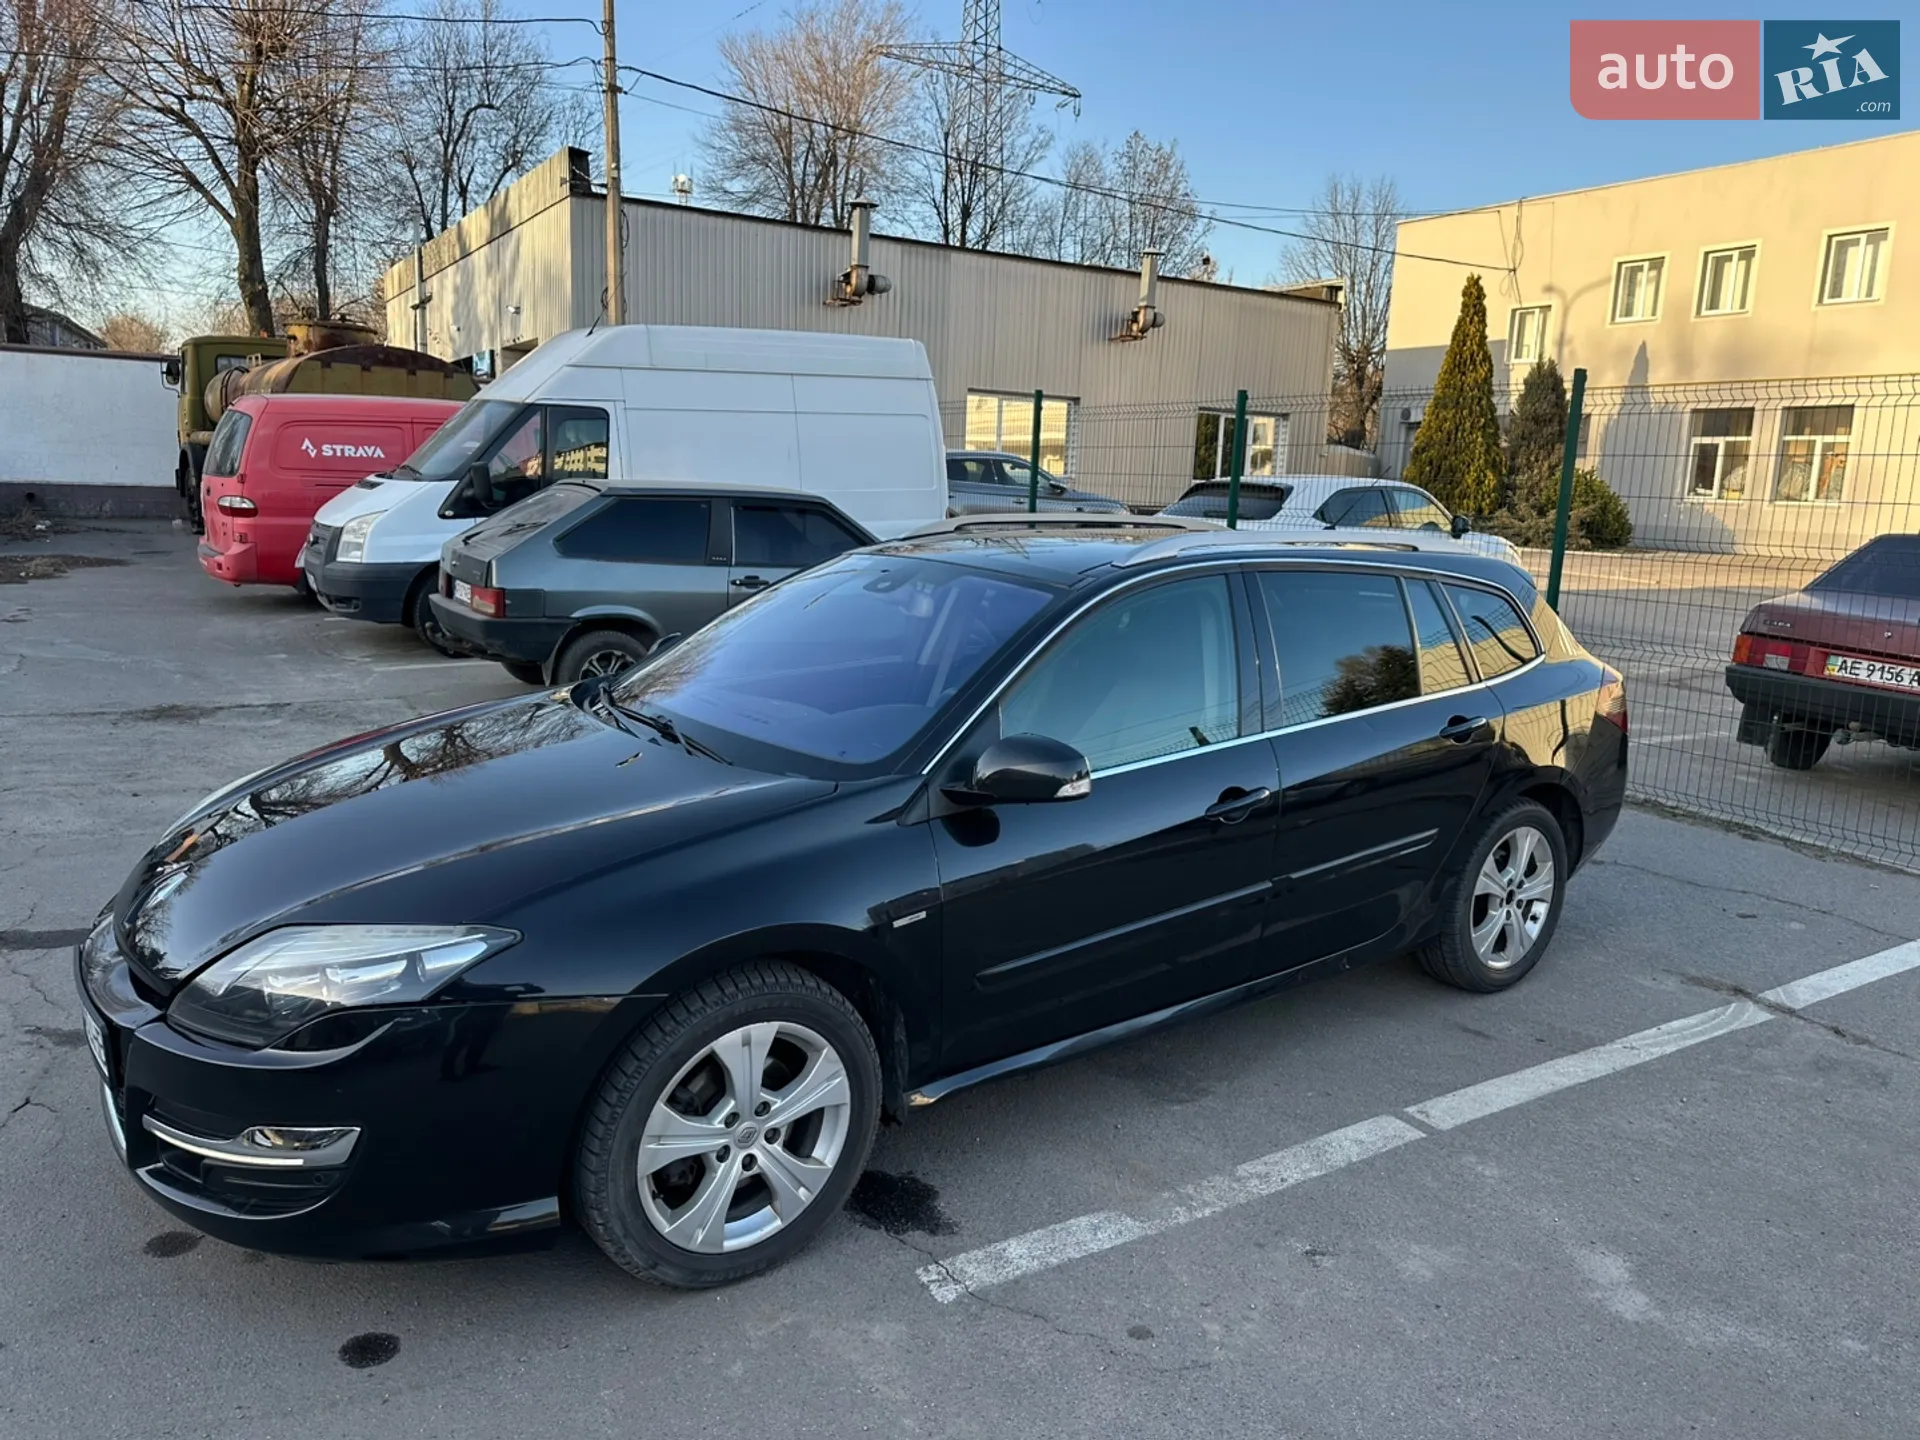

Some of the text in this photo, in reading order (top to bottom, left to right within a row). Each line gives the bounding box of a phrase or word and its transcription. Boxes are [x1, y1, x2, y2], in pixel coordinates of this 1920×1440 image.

[321, 444, 386, 459] STRAVA
[1837, 659, 1862, 677] AE
[1866, 663, 1906, 683] 9156
